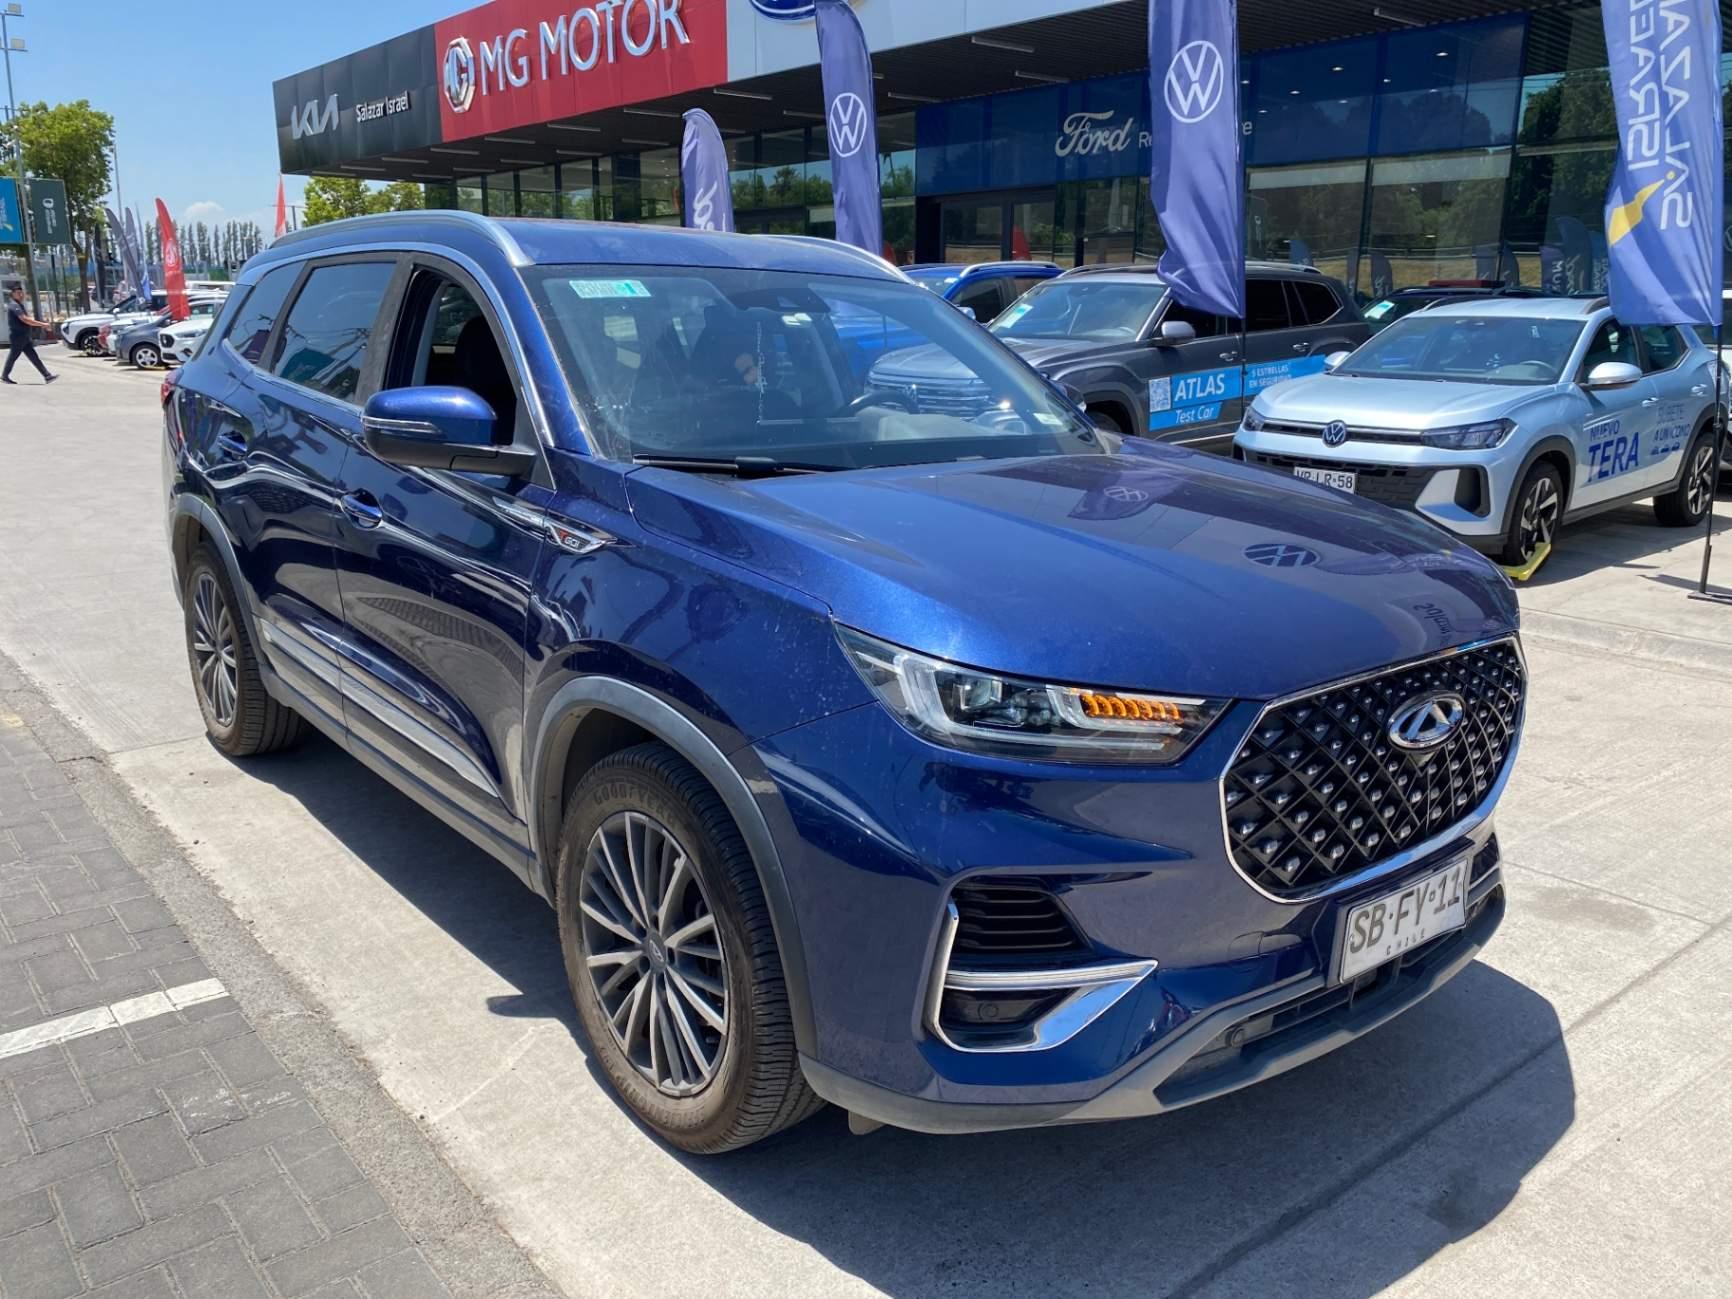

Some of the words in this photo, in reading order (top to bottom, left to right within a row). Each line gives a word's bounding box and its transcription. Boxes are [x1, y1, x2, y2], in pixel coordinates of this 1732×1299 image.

[480, 28, 530, 95] MG
[539, 0, 691, 80] MOTOR
[290, 93, 339, 139] KIA
[355, 101, 384, 122] Salazar
[385, 89, 409, 115] Israel
[1054, 110, 1134, 157] Ford
[1174, 373, 1226, 402] ATLAS
[1175, 408, 1196, 424] Test
[1197, 406, 1214, 420] Car
[1589, 419, 1620, 442] NUEVO
[1588, 431, 1639, 483] TERA
